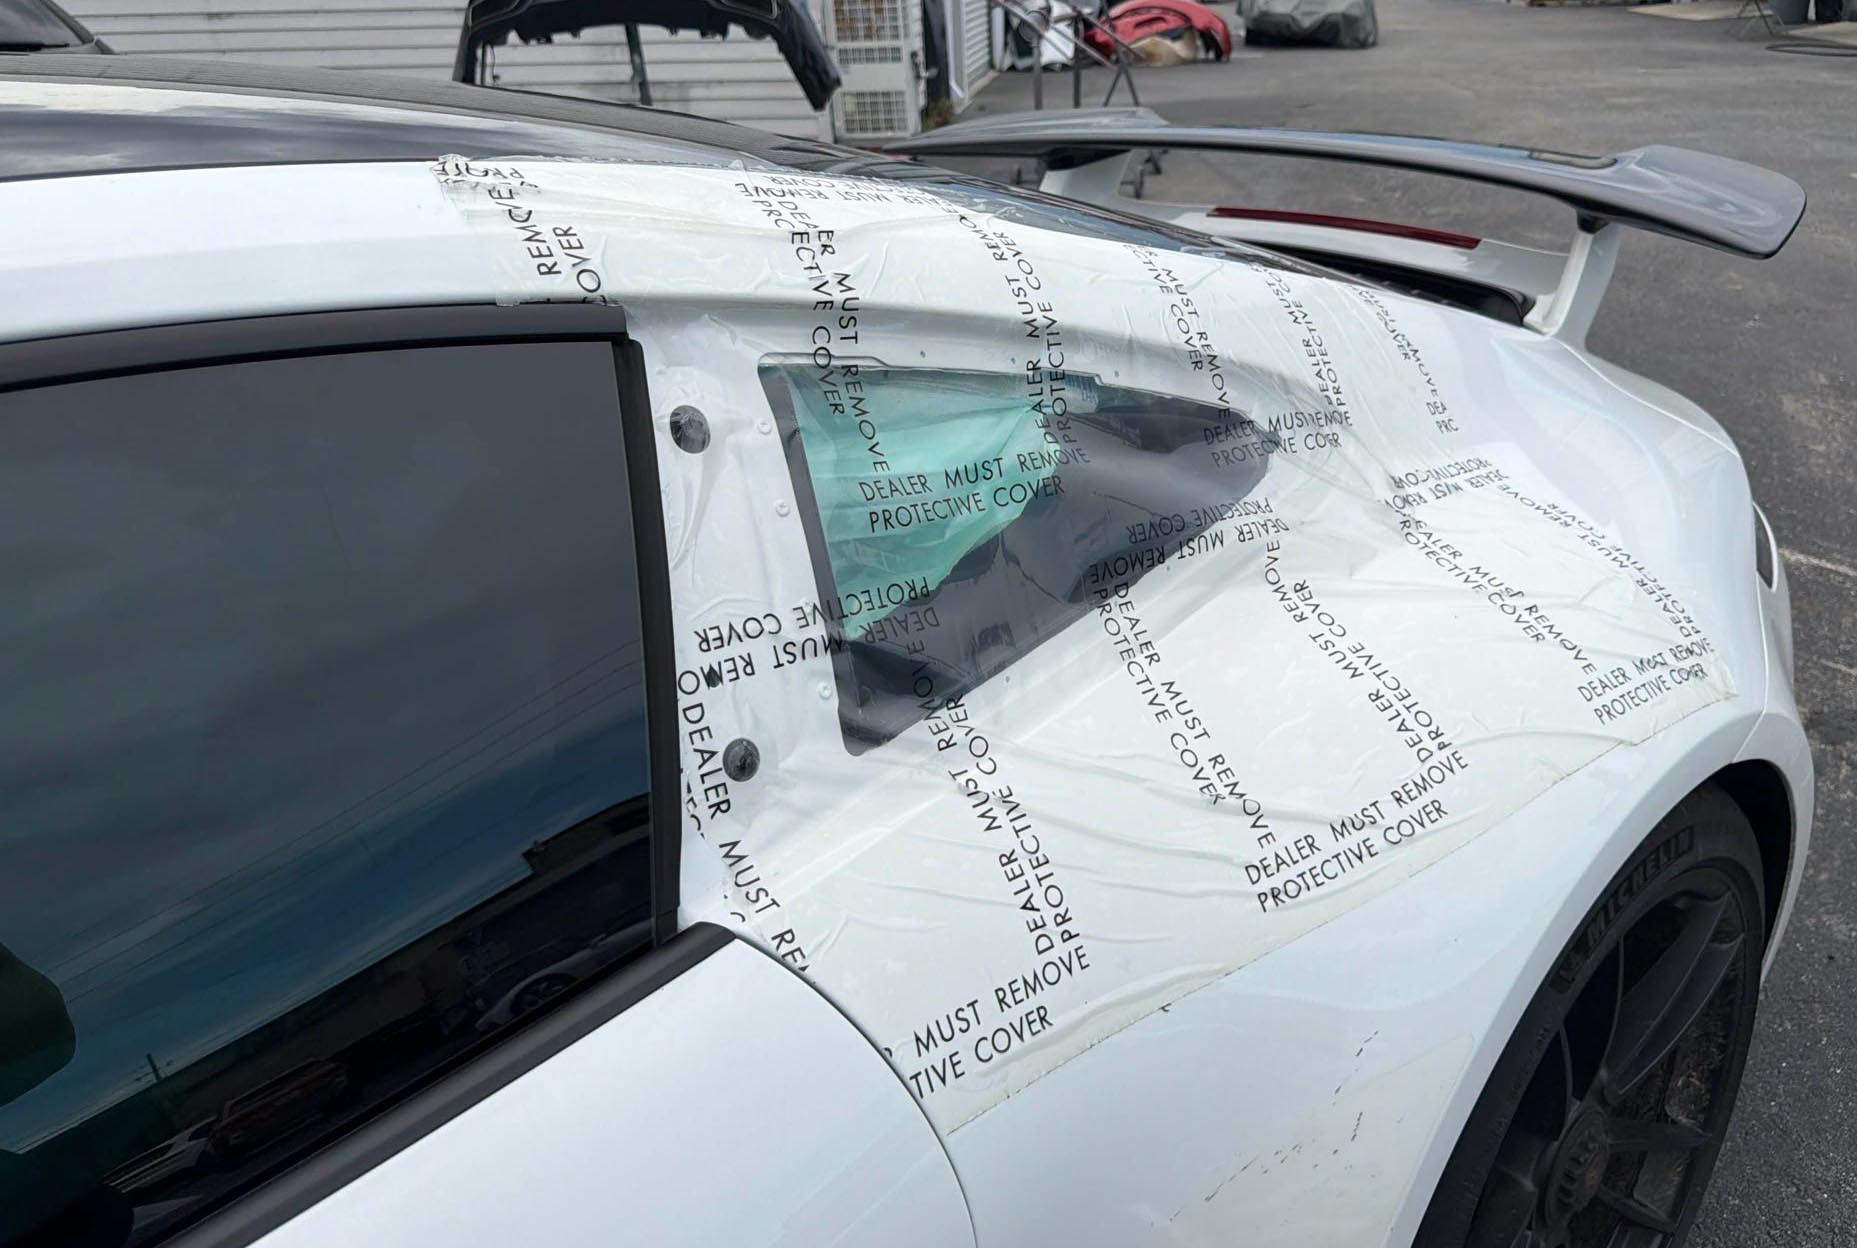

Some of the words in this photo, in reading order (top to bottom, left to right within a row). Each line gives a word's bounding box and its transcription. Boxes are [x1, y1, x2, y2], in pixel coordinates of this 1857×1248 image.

[994, 231, 1042, 292] COVER
[833, 272, 861, 345] MUST
[1004, 274, 1042, 339] MUST
[1170, 302, 1205, 372] COVER
[811, 326, 847, 416] COVER
[1039, 300, 1078, 444] PROTECTIVE
[1160, 266, 1201, 320] MUST
[1195, 330, 1232, 420] REMOVE
[841, 364, 891, 473] REMOVE
[1026, 358, 1059, 444] DEALER
[1203, 419, 1259, 446] DEALER
[859, 474, 933, 502] DEALER
[944, 457, 1005, 490] MUST
[1016, 446, 1091, 473] REMOVE
[869, 491, 987, 534] PROTECTIVE
[993, 475, 1065, 508] COVER
[1125, 513, 1187, 544] COVER
[1175, 528, 1225, 561] MUST
[1195, 497, 1274, 528] PROTECTIVE
[1237, 517, 1291, 544] DEALER
[1088, 544, 1166, 585] REMOVE
[1264, 539, 1310, 624] REMOVE
[1577, 533, 1629, 569] MUST
[693, 612, 783, 653] COVER
[793, 576, 932, 630] PROTECTIVE
[859, 606, 940, 646] DEALER
[1293, 579, 1347, 639] COVER
[1487, 591, 1547, 645] COVER
[772, 631, 845, 671] MUST
[1308, 631, 1365, 680] MUST
[1524, 603, 1598, 676] REMOVE
[905, 640, 958, 752] REMOVE
[1092, 587, 1173, 724] PROTECTIVE
[1169, 732, 1228, 806] COVER
[1114, 582, 1162, 667] DEALER
[1161, 680, 1211, 742] MUST
[1208, 753, 1277, 850] REMOVE
[1348, 641, 1454, 752] PROTECTIVE
[1577, 667, 1633, 703] DEALER
[1593, 674, 1672, 726] PROTECTIVE
[945, 693, 998, 776] COVER
[1368, 689, 1434, 764] DEALER
[682, 702, 733, 821] DEALER
[718, 840, 781, 915] MUST
[947, 768, 1003, 832] MUST
[1244, 833, 1322, 886] DEALER
[1329, 800, 1386, 843] MUST
[1390, 750, 1470, 809] REMOVE
[991, 785, 1082, 944] PROTECTIVE
[1256, 837, 1381, 914] PROTECTIVE
[1383, 799, 1449, 847] COVER
[998, 849, 1056, 956] DEALER
[912, 999, 984, 1059] MUST
[994, 945, 1091, 1013] REMOVE
[974, 1004, 1054, 1064] COVER
